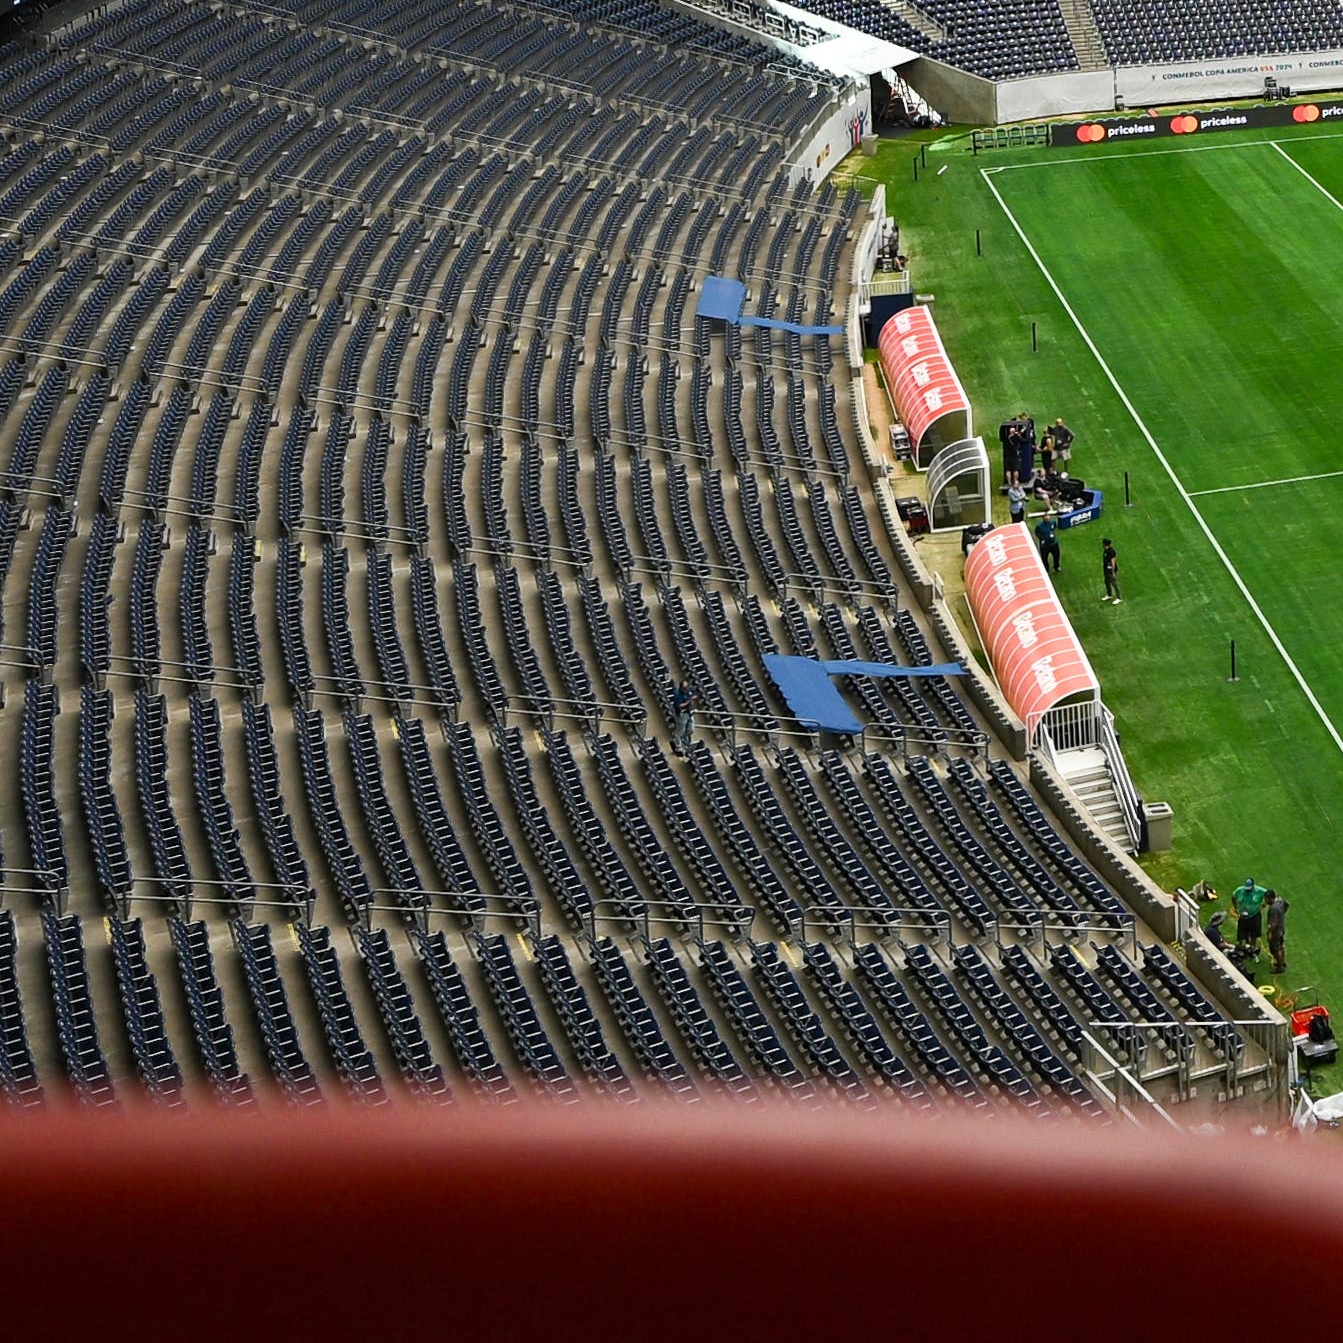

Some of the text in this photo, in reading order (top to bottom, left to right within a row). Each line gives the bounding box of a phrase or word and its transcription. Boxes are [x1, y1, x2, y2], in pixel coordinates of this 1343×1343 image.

[1107, 124, 1156, 138] priceless
[1200, 116, 1248, 129] priceless
[985, 533, 1007, 566] Betano
[993, 567, 1018, 602] Betano
[1011, 610, 1039, 649] Betano
[1031, 654, 1058, 694] Betano
